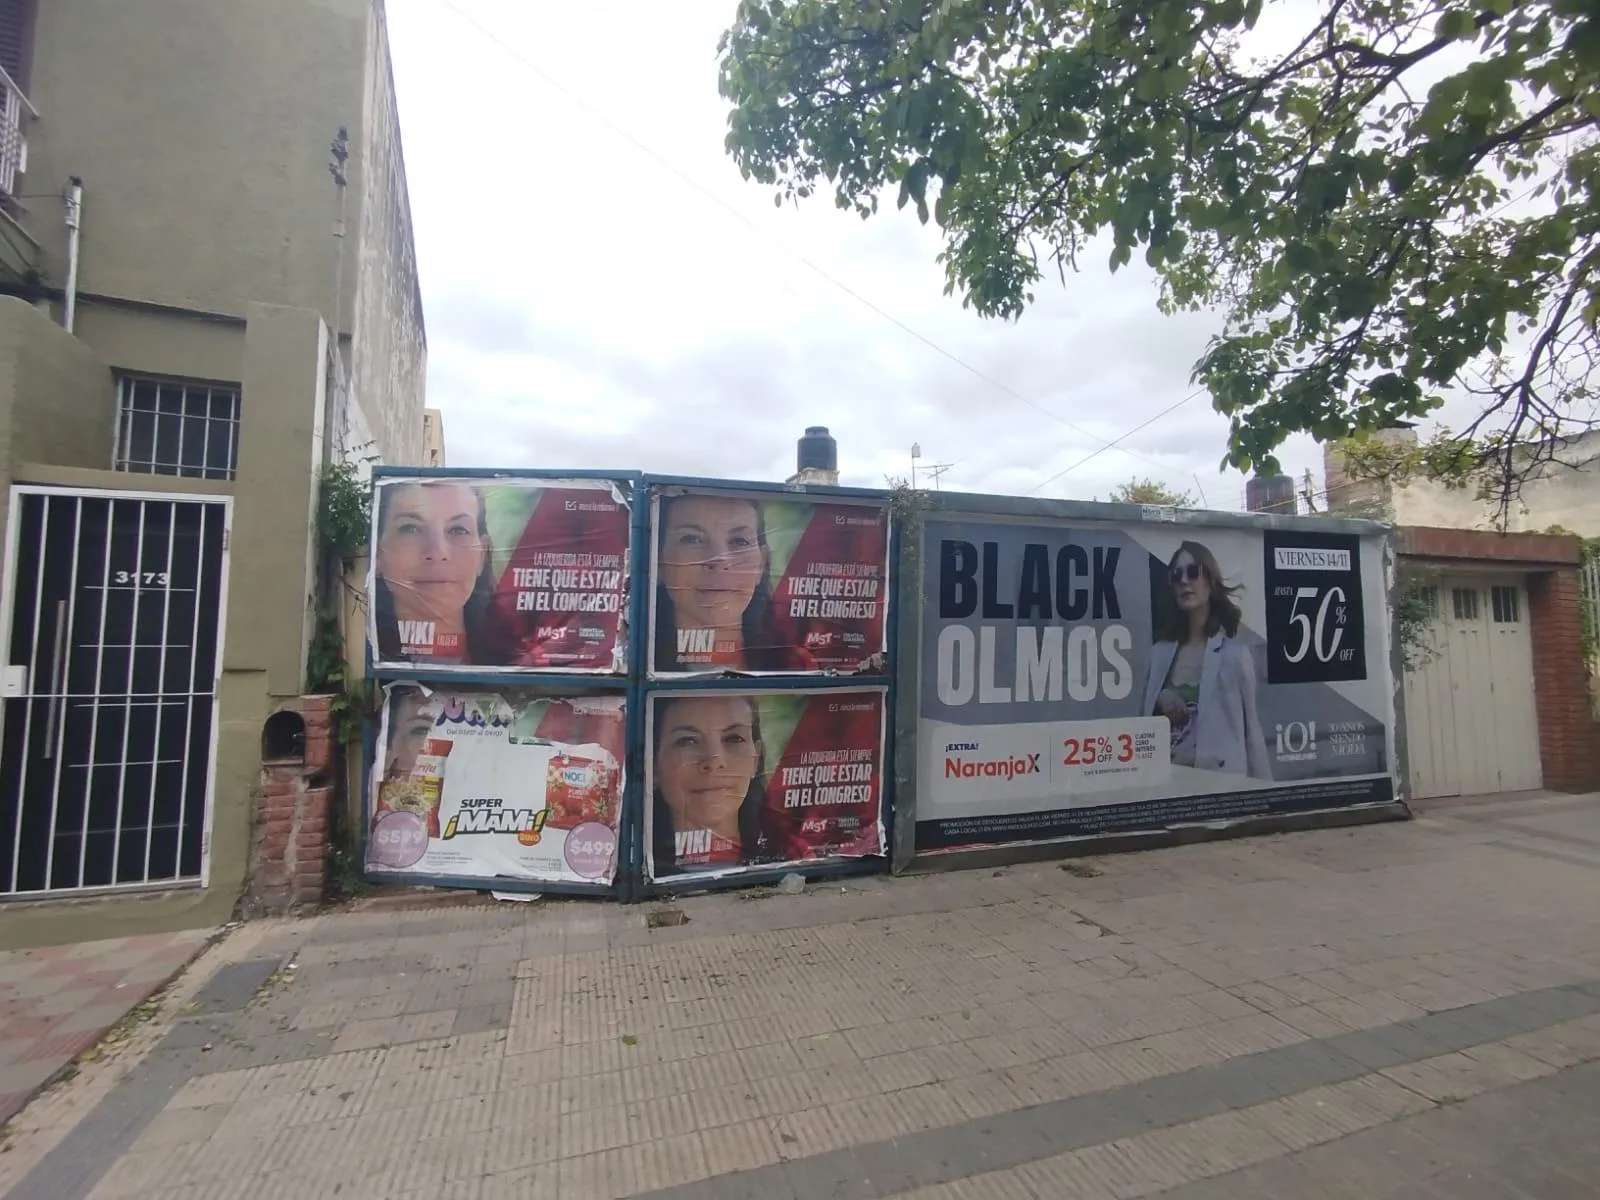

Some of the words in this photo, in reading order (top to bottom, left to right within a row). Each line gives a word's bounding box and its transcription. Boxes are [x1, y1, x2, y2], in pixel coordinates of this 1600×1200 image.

[1278, 551, 1325, 567] VIERNES
[1327, 553, 1348, 567] 14/11
[115, 570, 168, 585] 3173
[513, 567, 551, 588] TIENE
[552, 569, 577, 591] QUE
[579, 570, 620, 590] ESTAR
[940, 540, 1122, 621] BLACK
[788, 577, 819, 596] TIENE
[820, 578, 842, 599] QUE
[844, 579, 877, 597] ESTAR
[516, 591, 535, 611] EN
[536, 592, 551, 611] EL
[552, 592, 619, 612] CONGRESO
[790, 599, 806, 617] EN
[807, 599, 820, 618] EL
[820, 600, 876, 619] CONGRESO
[398, 620, 436, 645] VIKI
[538, 627, 567, 640] MST
[677, 629, 715, 652] VIKI
[807, 632, 833, 645] MST
[1340, 648, 1355, 661] OFF
[937, 624, 1133, 706] OLMOS
[945, 743, 979, 752] ¡EXTRA!
[1117, 733, 1134, 763] 3
[1097, 754, 1113, 763] OFF
[782, 767, 814, 787] TIENE
[814, 765, 838, 787] QUE
[838, 764, 873, 782] ESTAR
[460, 798, 503, 808] SUPER
[784, 788, 800, 808] EN
[800, 788, 813, 807] EL
[814, 785, 872, 805] CONGRESO
[802, 819, 828, 833] MST
[570, 840, 614, 856] $499
[674, 828, 712, 857] VIKI
